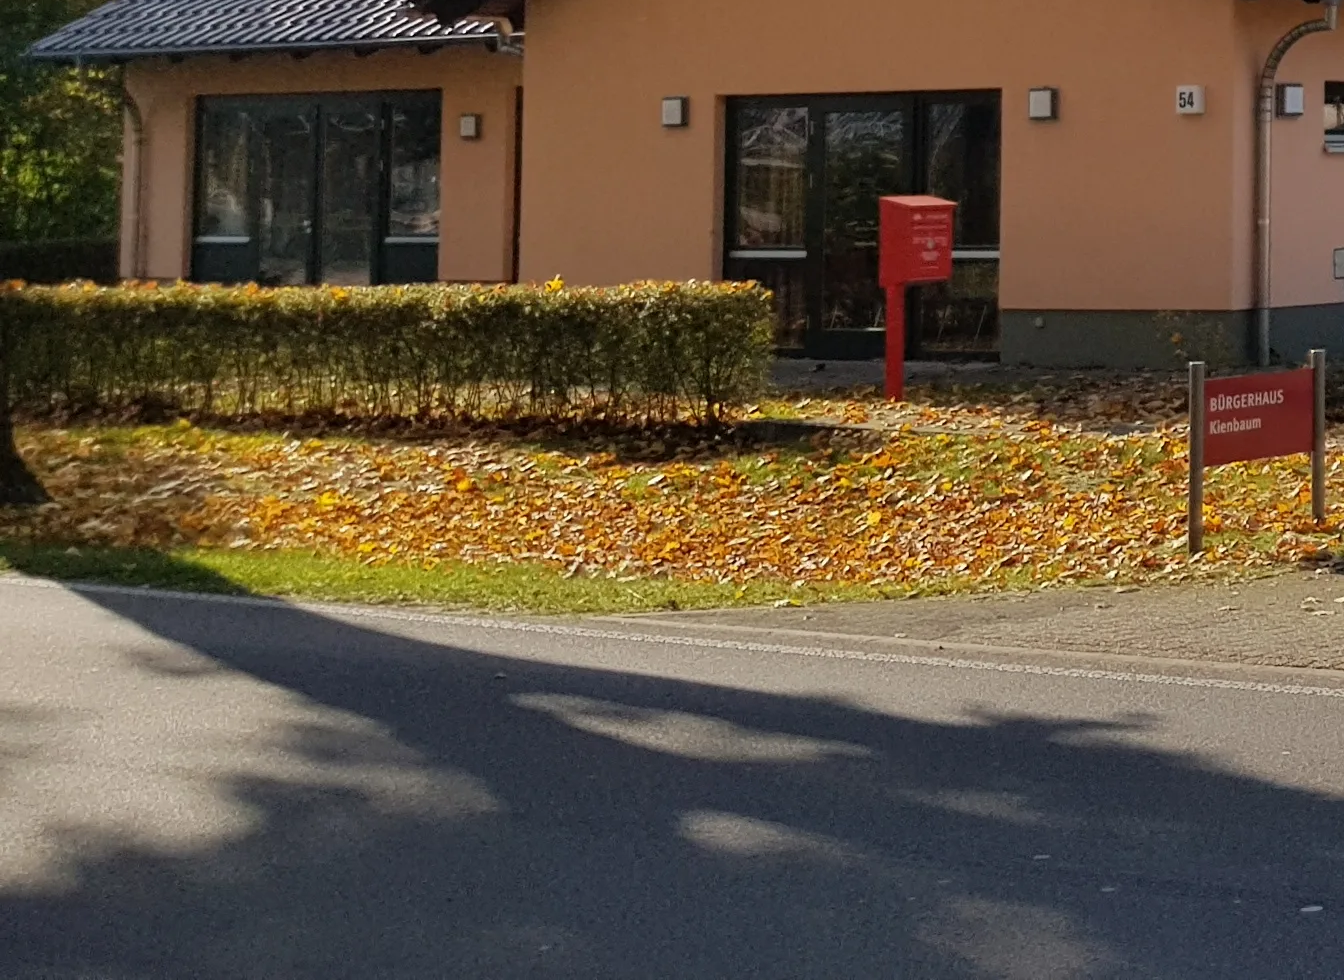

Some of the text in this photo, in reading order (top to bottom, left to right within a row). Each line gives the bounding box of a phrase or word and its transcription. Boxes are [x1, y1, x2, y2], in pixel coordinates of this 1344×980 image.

[1179, 91, 1194, 108] 54
[1209, 389, 1284, 412] BÜRGERHAUS
[1209, 417, 1261, 435] Kienbaum
